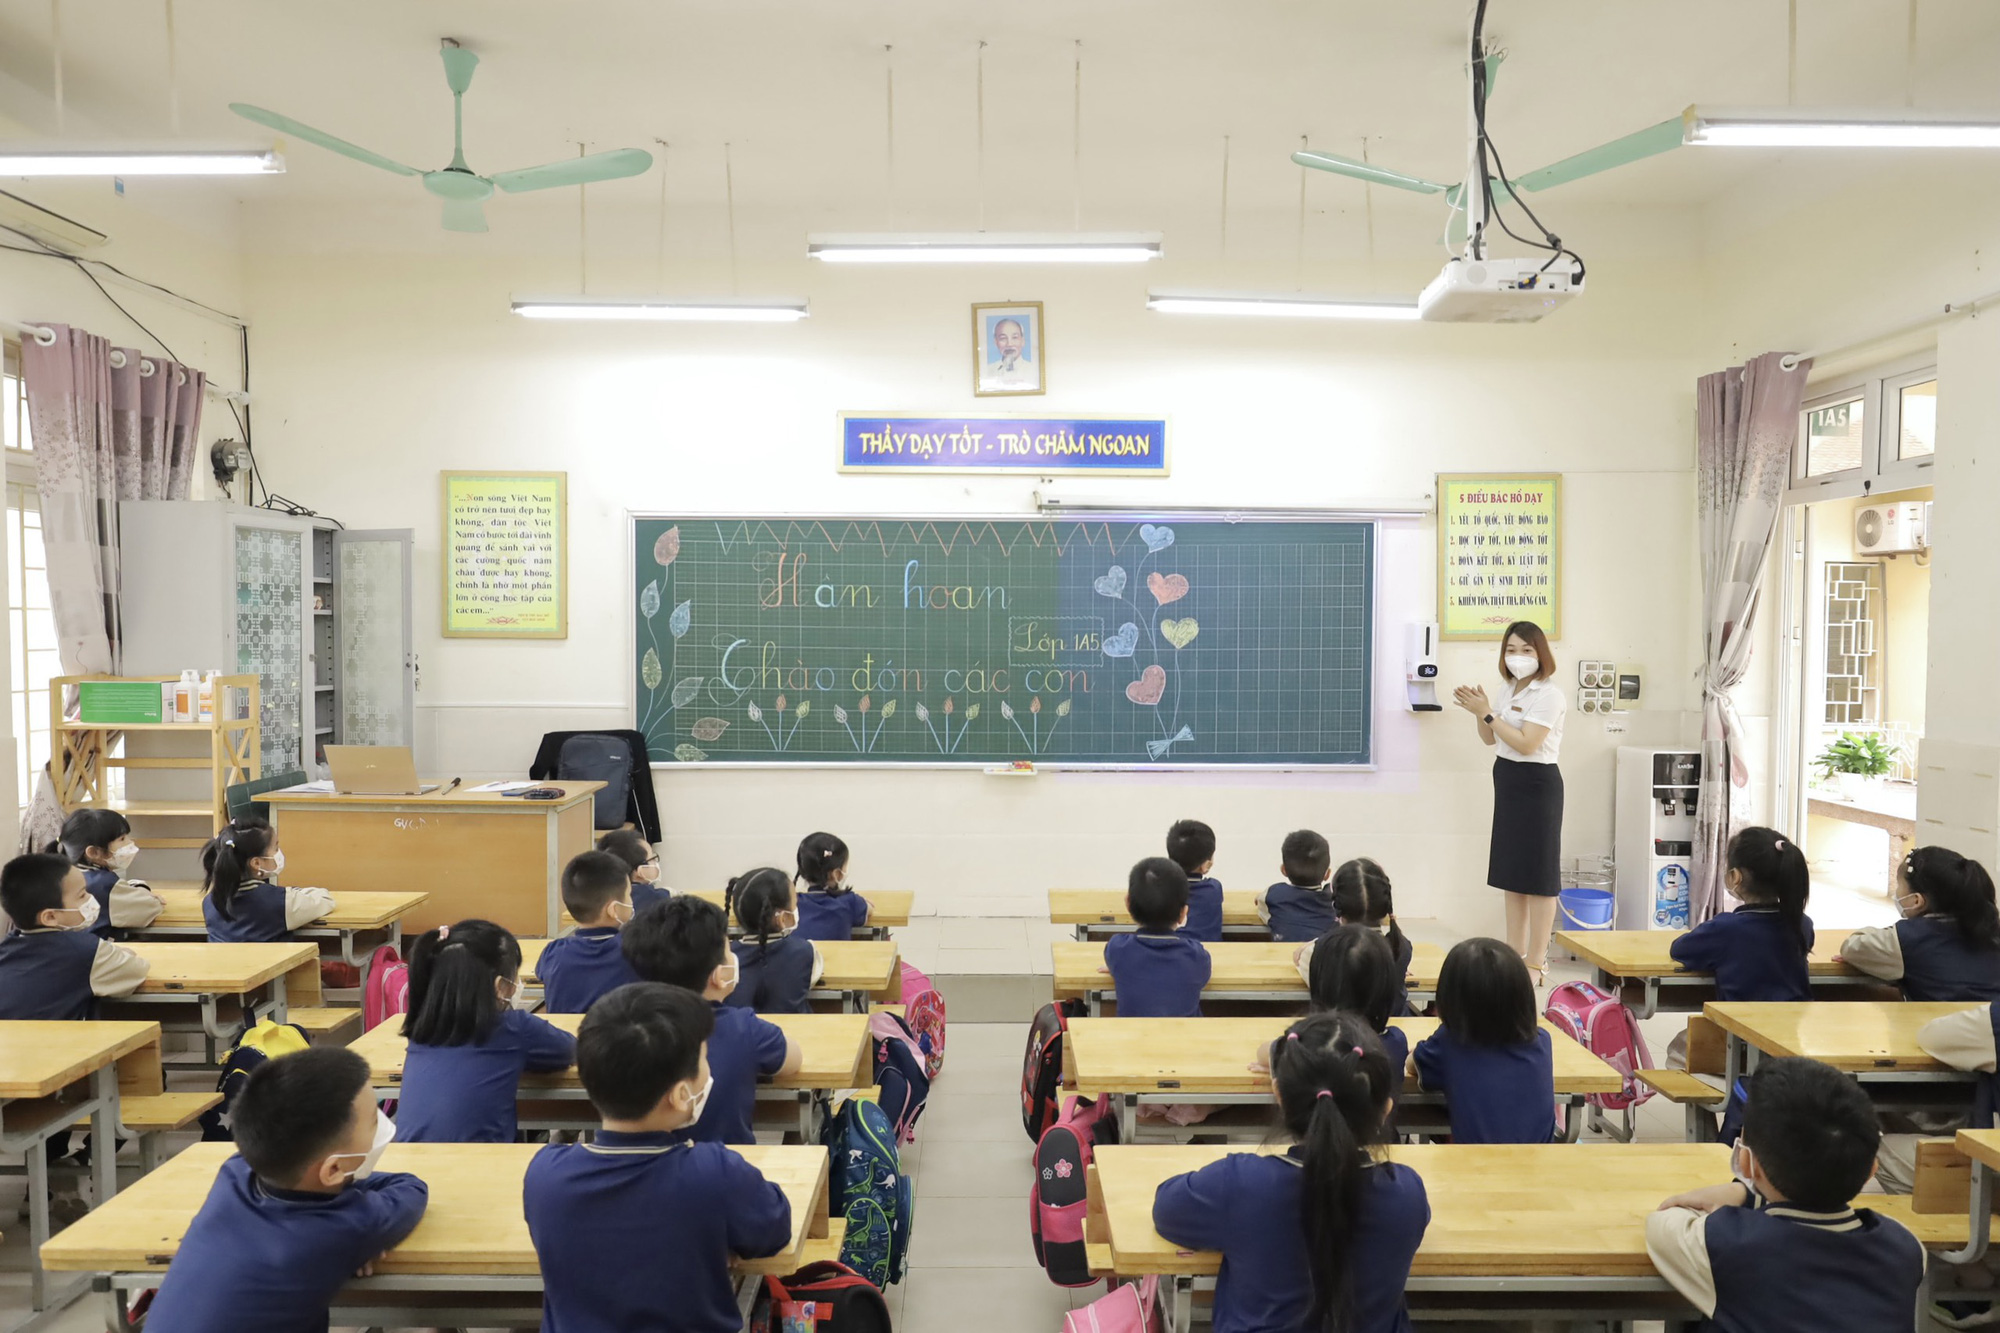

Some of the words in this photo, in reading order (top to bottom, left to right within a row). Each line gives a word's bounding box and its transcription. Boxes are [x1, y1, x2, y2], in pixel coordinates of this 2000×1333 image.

[1818, 408, 1847, 427] 1A5
[859, 424, 906, 455] THẦY
[909, 432, 947, 459] DẠY
[949, 424, 984, 456] TỐT
[997, 429, 1032, 456] TRÒ
[1035, 430, 1086, 456] CHĂM
[1088, 433, 1150, 456] NGOAN
[1460, 494, 1464, 503] 5
[1467, 488, 1488, 503] ĐIỀU
[1491, 490, 1508, 503] BÁC
[1510, 488, 1522, 503] HỒ
[1524, 493, 1543, 505] DẠY
[899, 559, 1011, 610] hoan
[1013, 621, 1066, 660] Lớp
[1073, 633, 1100, 652] 1A5
[708, 633, 835, 706] Chào
[852, 652, 926, 693] đón
[944, 661, 1010, 693] các
[1024, 668, 1094, 693] con
